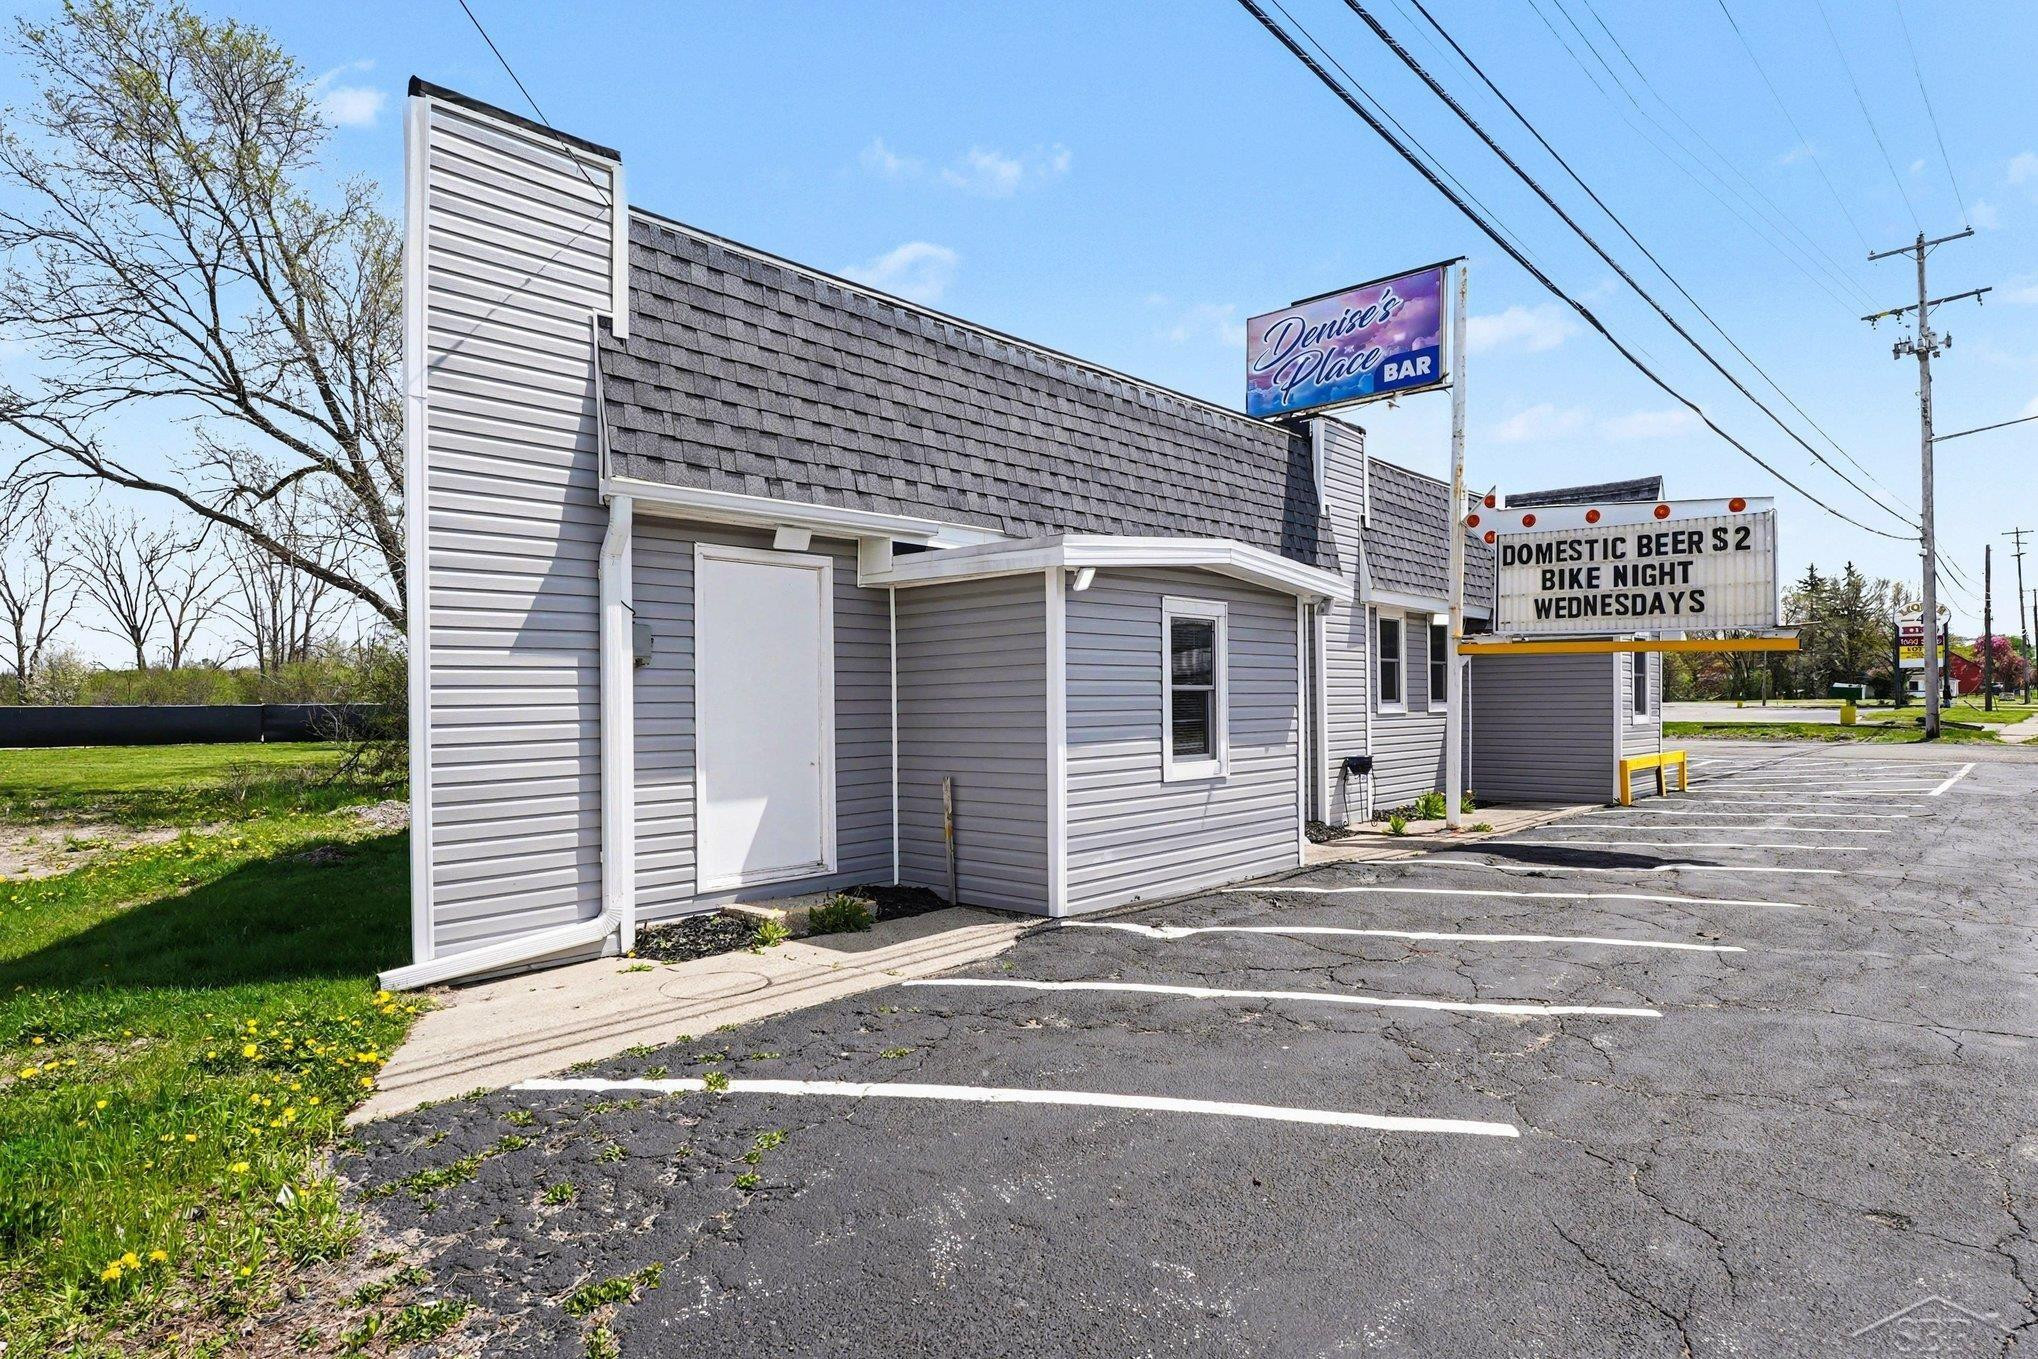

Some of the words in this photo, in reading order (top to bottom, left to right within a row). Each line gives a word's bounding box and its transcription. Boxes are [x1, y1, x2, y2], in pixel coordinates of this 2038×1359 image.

[1253, 288, 1402, 372] Denise's
[1272, 347, 1382, 405] Place
[1383, 355, 1432, 382] BAR
[1502, 536, 1627, 567] DOMESTIC
[1637, 530, 1704, 558] BEER
[1541, 566, 1601, 590] BIKE
[1613, 560, 1693, 588] NIGHT
[1534, 589, 1706, 620] WEDNESDAYS
